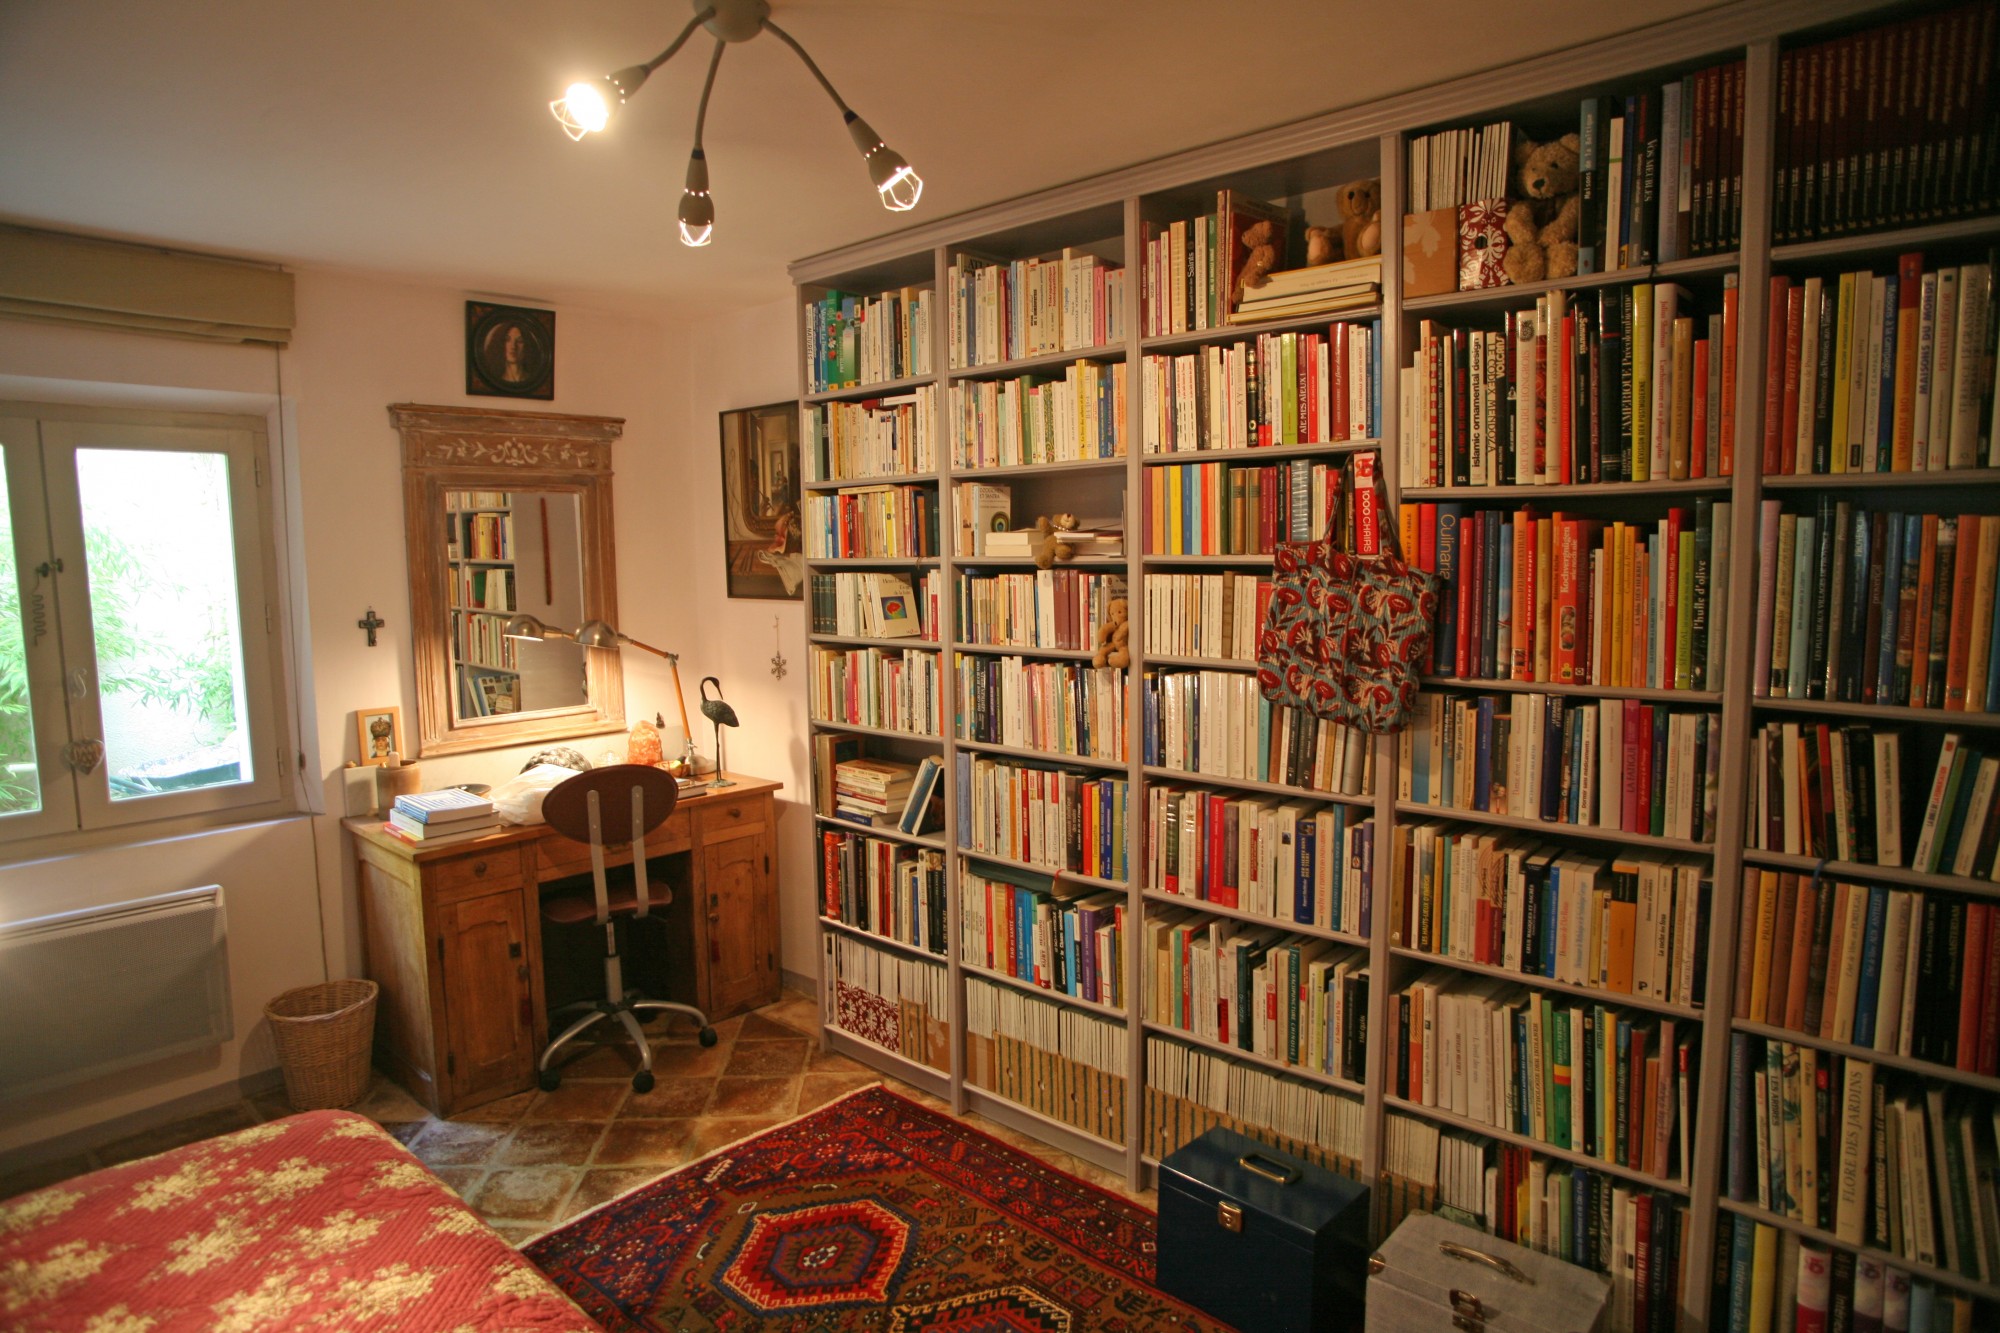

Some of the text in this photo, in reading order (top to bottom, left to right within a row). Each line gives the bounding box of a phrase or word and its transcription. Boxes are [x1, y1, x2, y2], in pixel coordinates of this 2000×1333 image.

[1187, 252, 1195, 278] Saints
[1786, 291, 1799, 392] Boutis de Provence
[1881, 284, 1896, 379] Maisons la campagne
[1918, 280, 1934, 395] MAISONS DU MONDE
[1938, 325, 1949, 372] PEINTURE
[1820, 339, 1831, 366] Poteries
[1820, 367, 1828, 378] des
[1961, 347, 1971, 359] LE
[1299, 403, 1307, 419] MES
[1471, 337, 1481, 468] islamic ornamental design
[1487, 343, 1496, 453] LE CODEX MENDOZA
[1520, 350, 1529, 477] ART POPULAIRE HONGROIS
[1817, 379, 1828, 410] Provence
[1899, 397, 1910, 414] BIO
[1898, 416, 1909, 461] L'HABITAT
[1362, 490, 1372, 553] 1000 CHAIRS
[1853, 516, 1865, 557] PROVENCE
[1440, 513, 1456, 580] Culinaria
[1560, 526, 1571, 593] Kochvergnügen
[1764, 541, 1773, 564] Vivre
[1693, 560, 1706, 630] l'huile d'olive
[1760, 580, 1770, 619] Provence
[1818, 578, 1827, 609] VILLAGES
[1871, 564, 1883, 605] provençal
[1815, 633, 1823, 651] PLUS
[1881, 609, 1893, 641] Provence
[1897, 608, 1912, 642] Provence
[1814, 651, 1822, 661] LES
[1582, 740, 1590, 776] médicaments
[1626, 746, 1636, 793] LA FATIGUE
[1581, 790, 1589, 809] Dormir
[1762, 888, 1774, 941] PROVENCE
[1851, 893, 1862, 929] PORTUGAL
[1871, 894, 1883, 927] ANTILLES
[1948, 905, 1960, 957] AMSTERDAM
[1868, 929, 1879, 943] AUX
[1534, 1074, 1542, 1118] MYTHOLOGIE
[1770, 1075, 1780, 1126] LES ARBRES
[1842, 1071, 1863, 1204] FLORE DES JARDINS
[1876, 1209, 1886, 1242] PLANTES
[1733, 1259, 1747, 1332] Intérieurs de la
